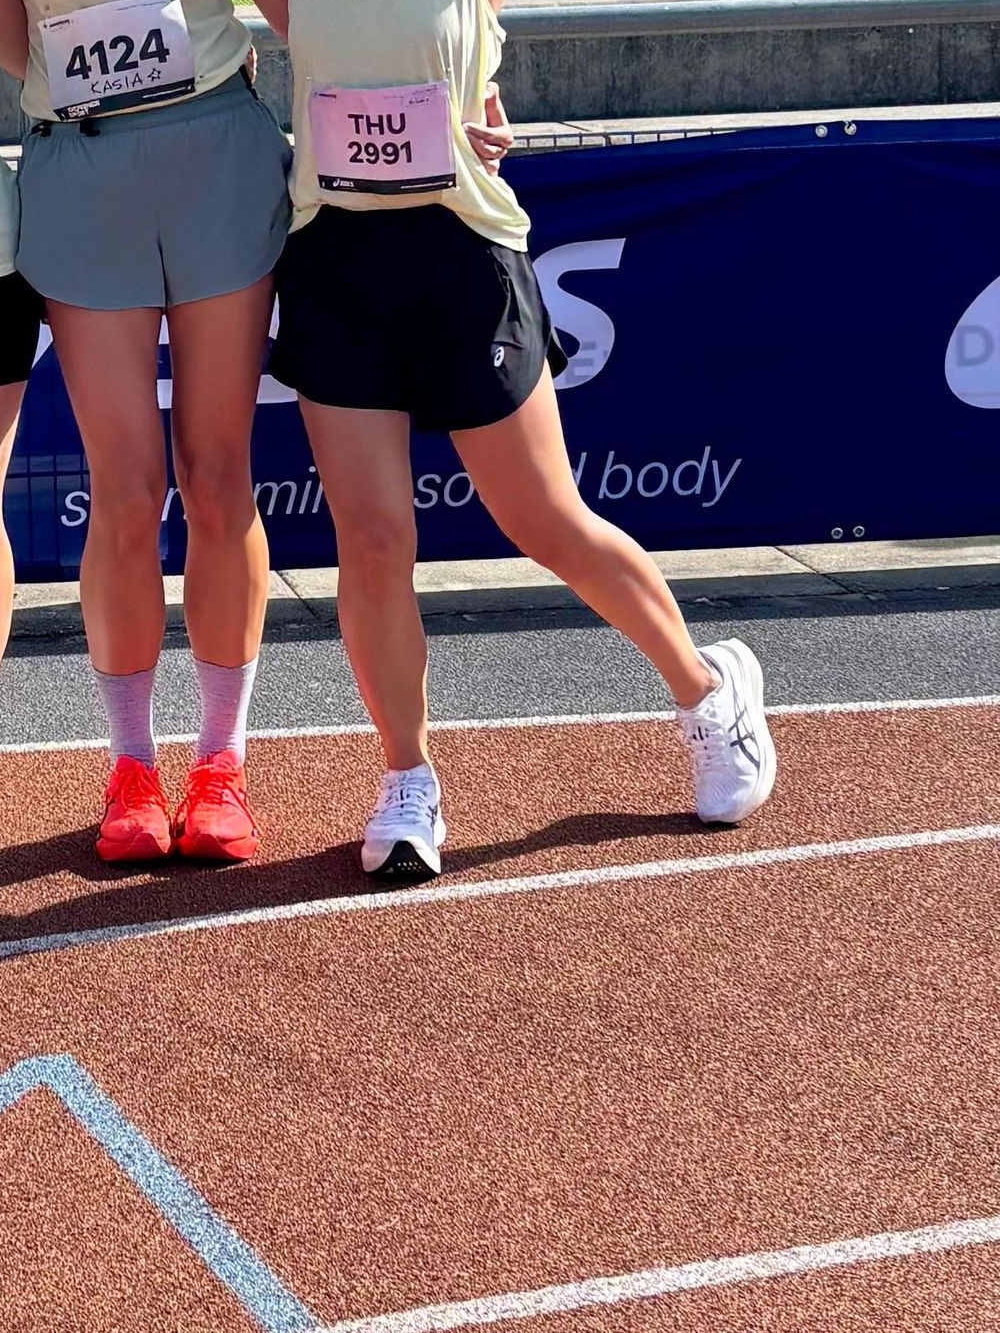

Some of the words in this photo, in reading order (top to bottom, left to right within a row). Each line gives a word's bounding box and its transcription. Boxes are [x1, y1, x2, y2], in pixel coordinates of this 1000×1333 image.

[65, 28, 170, 80] 4124
[90, 72, 143, 94] KASIA
[347, 112, 406, 135] THU
[347, 140, 412, 165] 2991
[598, 446, 742, 508] body
